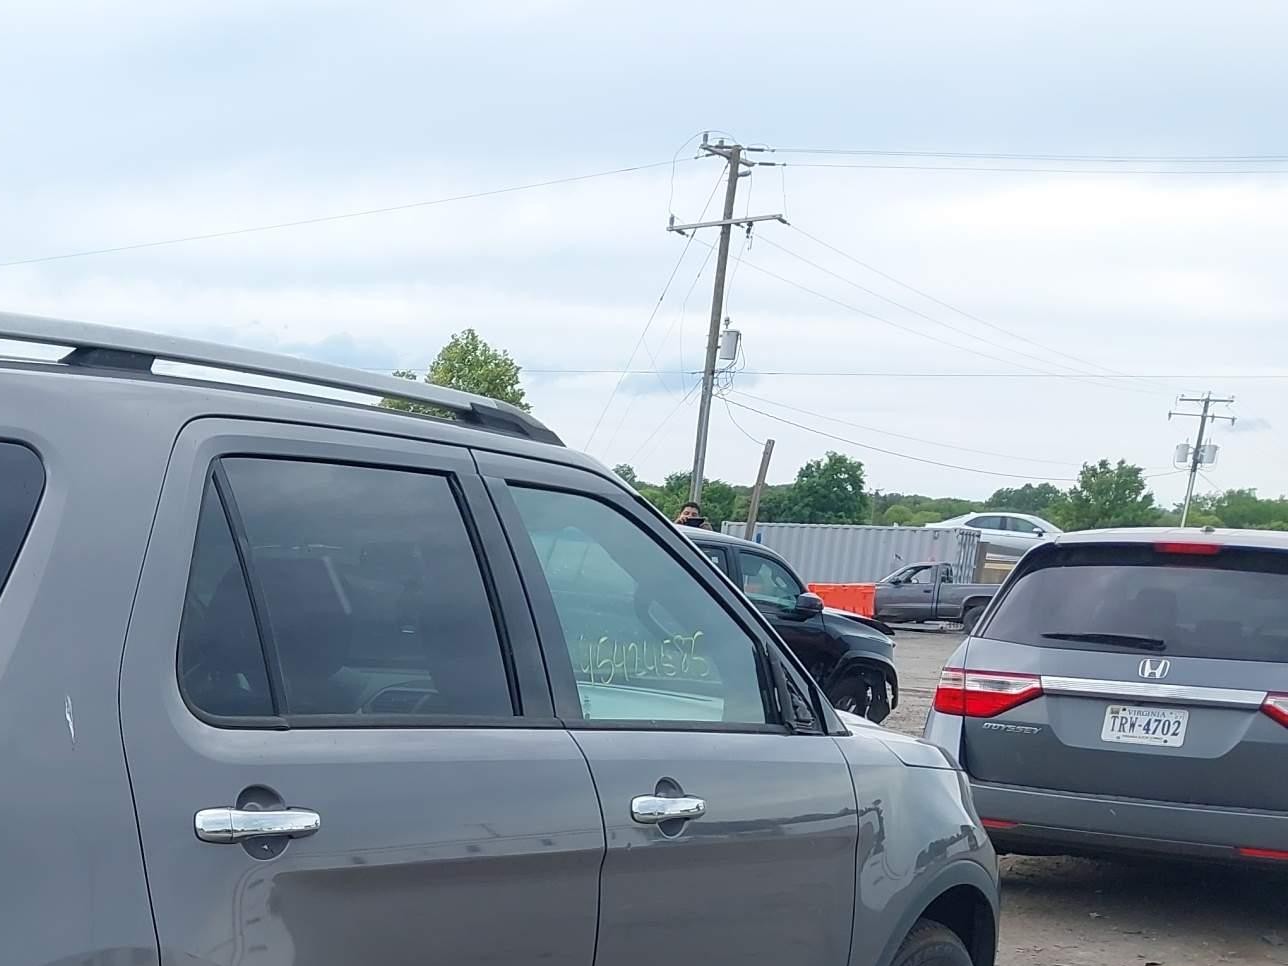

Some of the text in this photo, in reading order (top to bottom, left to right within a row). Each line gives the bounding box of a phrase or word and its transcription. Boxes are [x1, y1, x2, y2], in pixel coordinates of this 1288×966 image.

[1127, 708, 1167, 719] VIRGINIA
[981, 721, 1043, 735] ODYSSEY
[1110, 715, 1182, 738] TRW-4702
